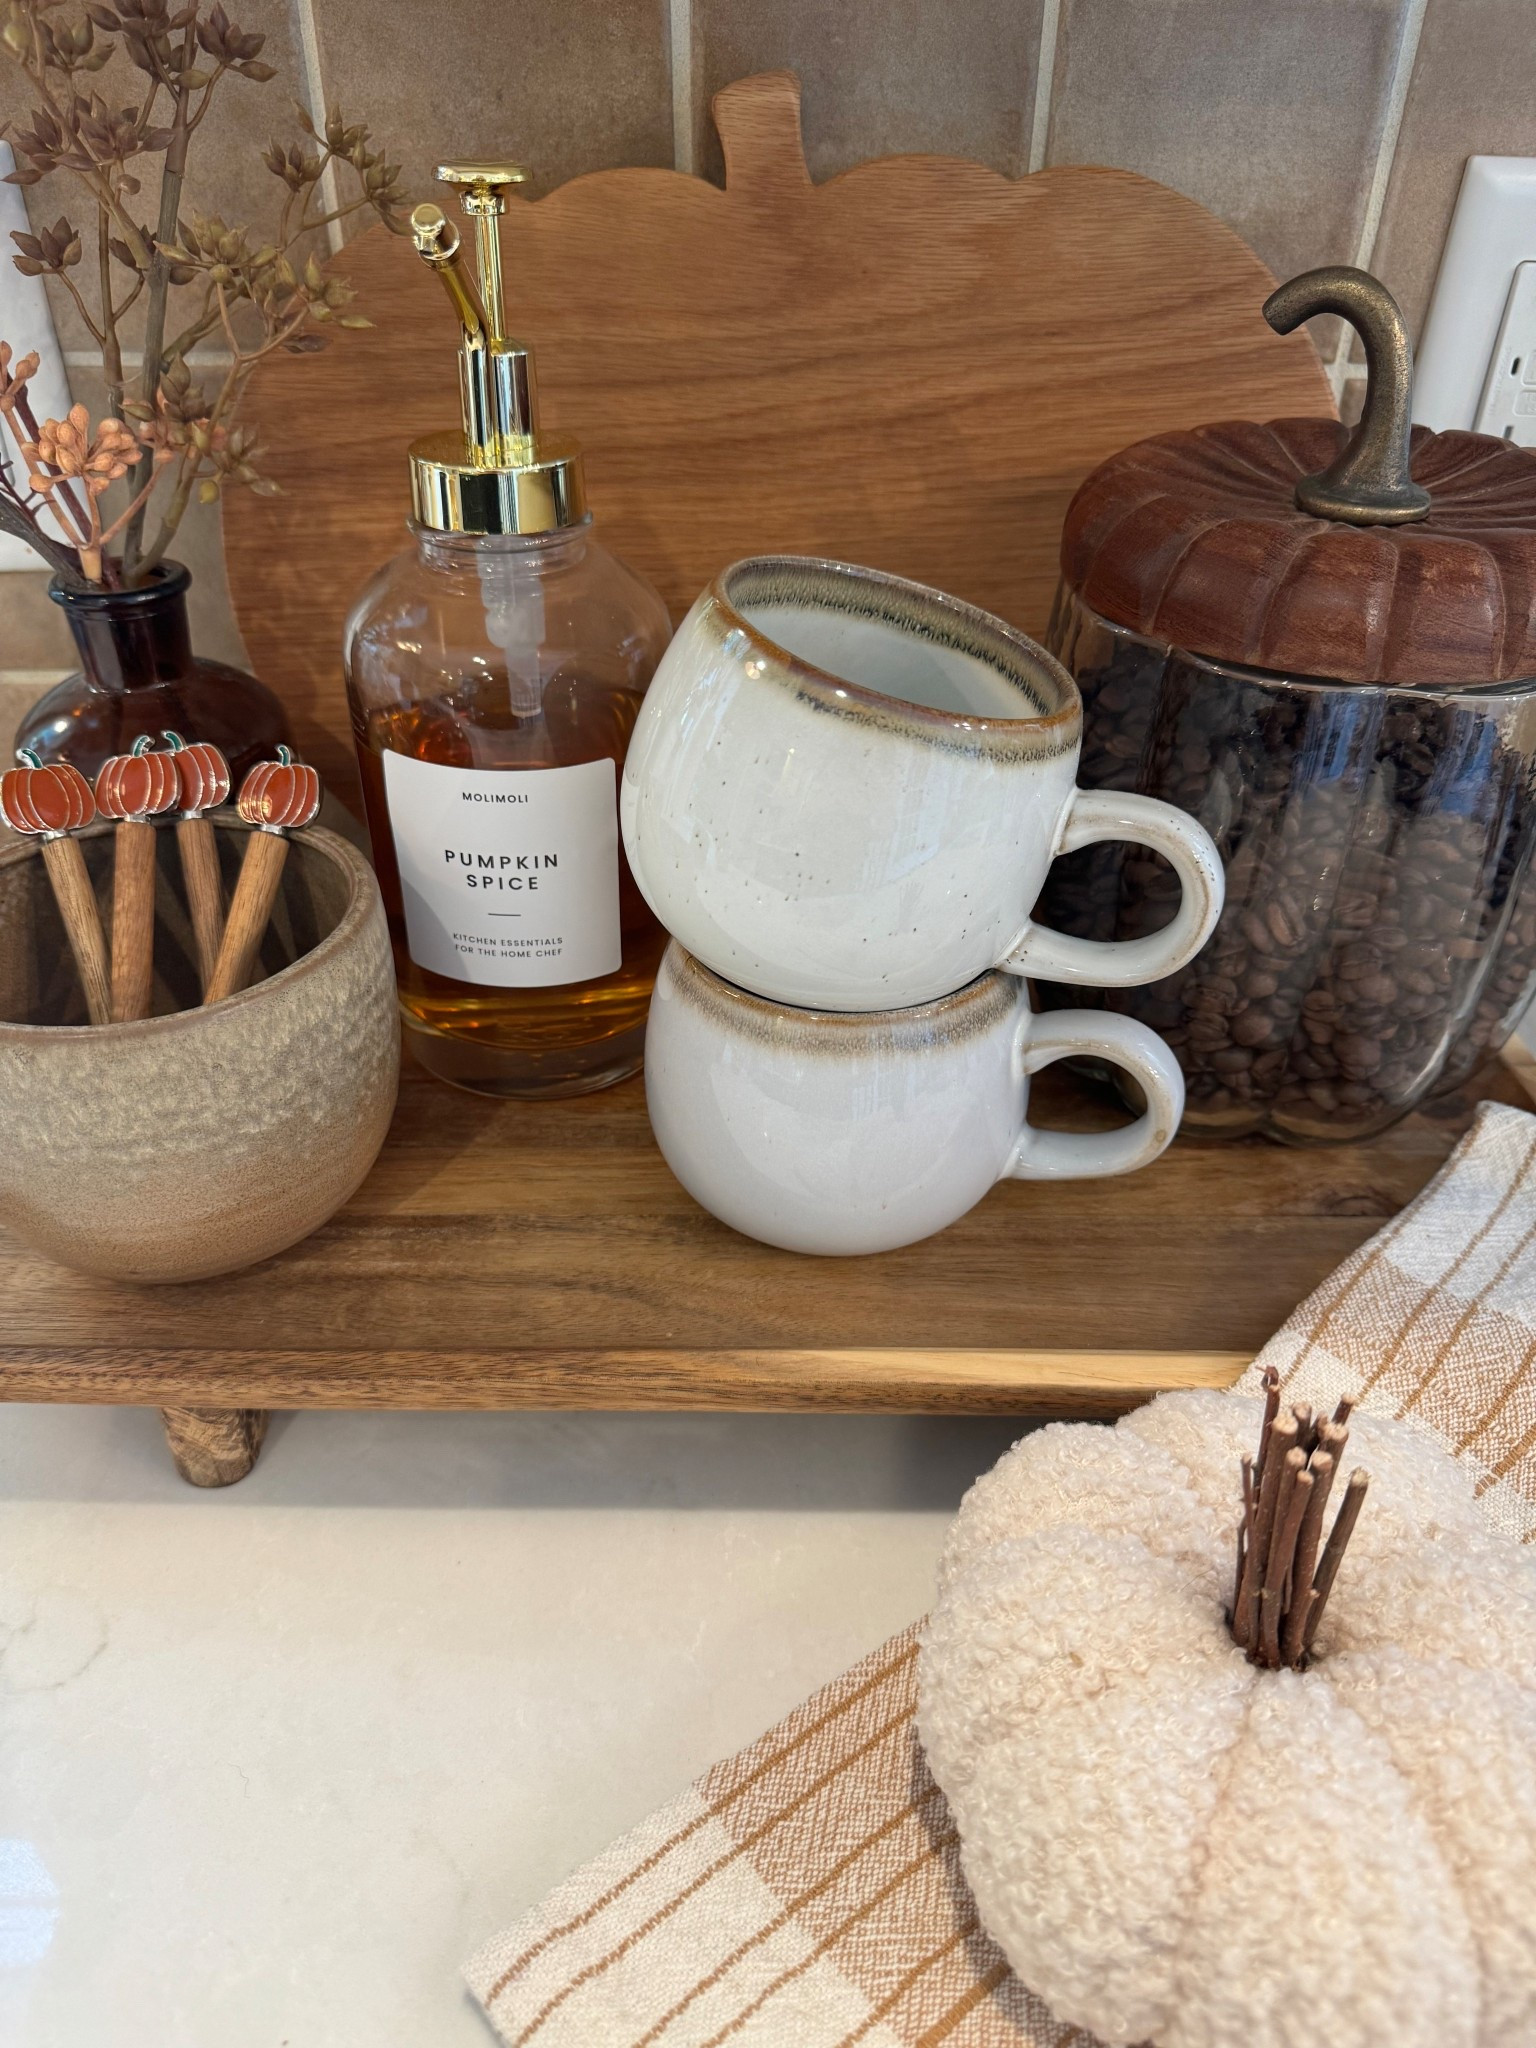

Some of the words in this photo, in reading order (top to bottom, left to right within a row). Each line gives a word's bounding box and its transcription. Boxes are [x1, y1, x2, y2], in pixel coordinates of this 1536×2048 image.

[462, 791, 529, 804] MOLIMOLI
[444, 849, 558, 870] PUMPKIN
[466, 873, 539, 891] SPICE
[453, 932, 497, 946] KITCHEN
[500, 936, 563, 947] ESSENTIALS
[455, 944, 474, 954] FOR
[478, 947, 497, 957] THE
[500, 950, 532, 958] HOME
[536, 948, 563, 958] CHEF
